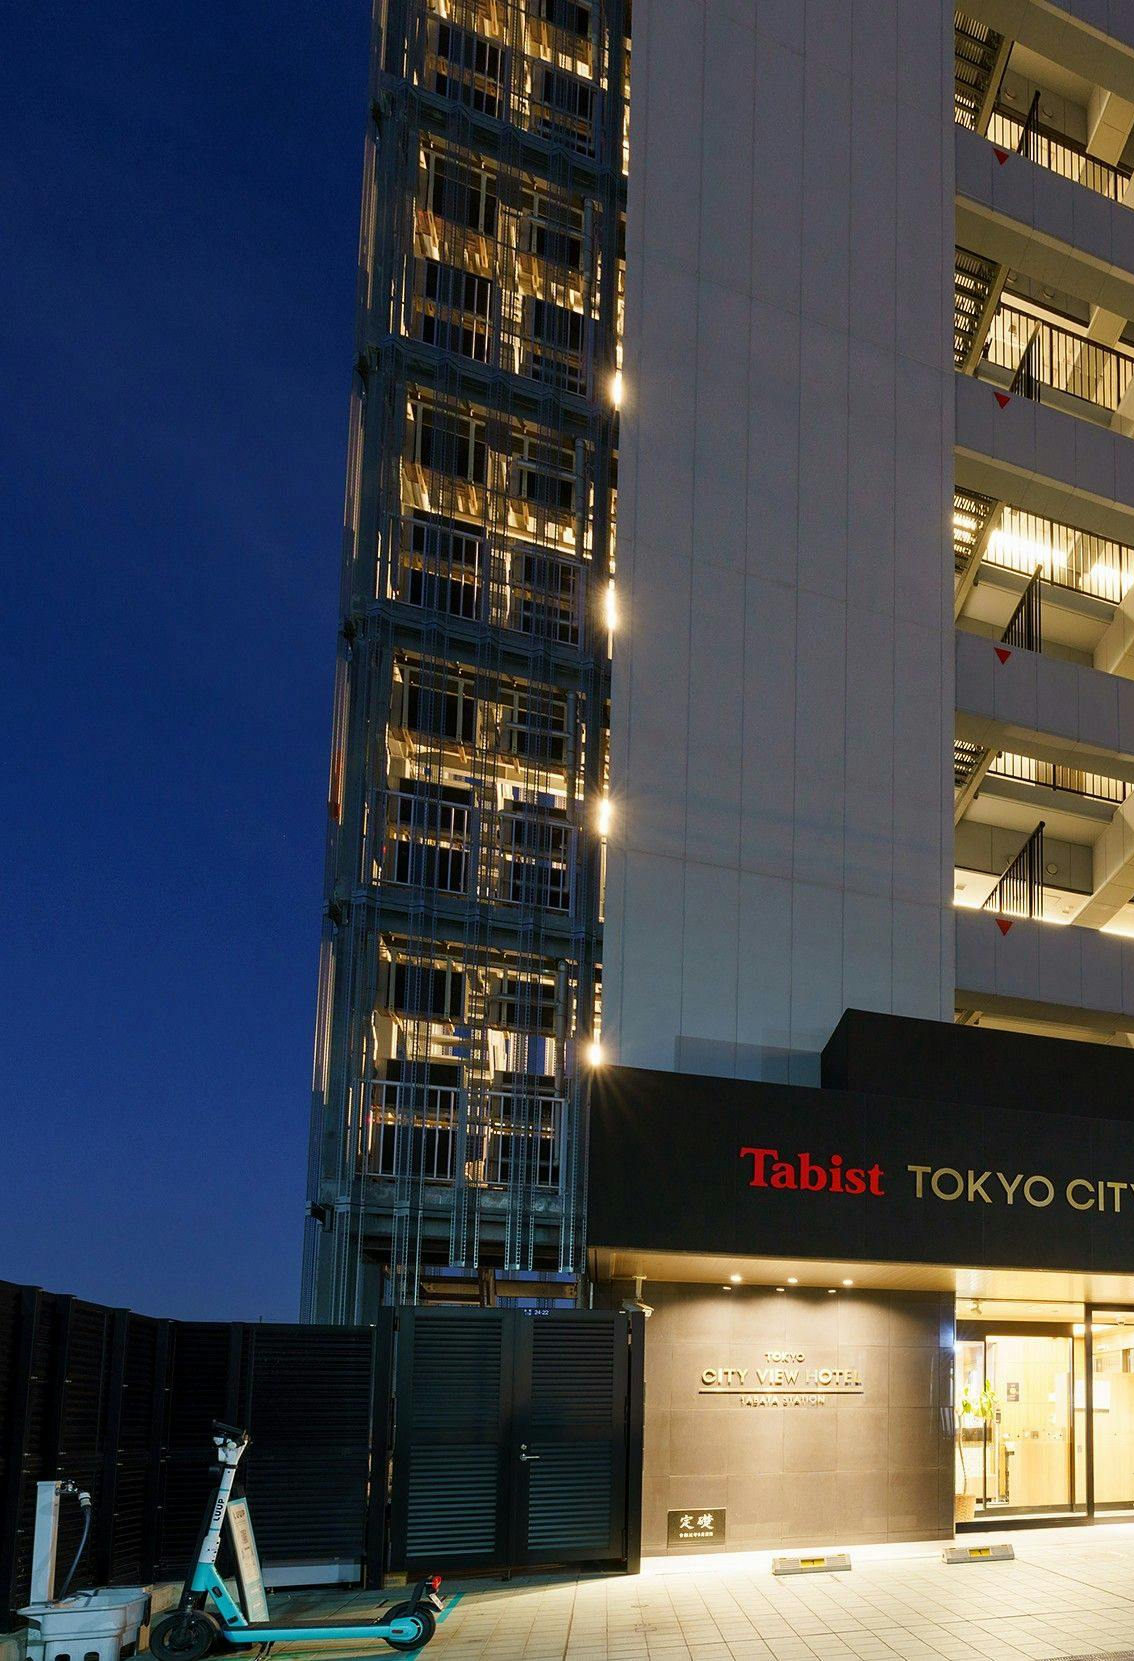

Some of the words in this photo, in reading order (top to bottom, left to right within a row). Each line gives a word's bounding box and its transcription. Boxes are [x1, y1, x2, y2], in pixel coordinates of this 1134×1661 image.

[740, 1147, 885, 1196] Tabist
[907, 1165, 1055, 1208] TOKYO
[765, 1351, 806, 1364] TOKYO
[701, 1367, 748, 1386] CITY
[756, 1367, 800, 1386] VIEW
[804, 1367, 863, 1387] HOTEL
[212, 1498, 225, 1522] LUUP
